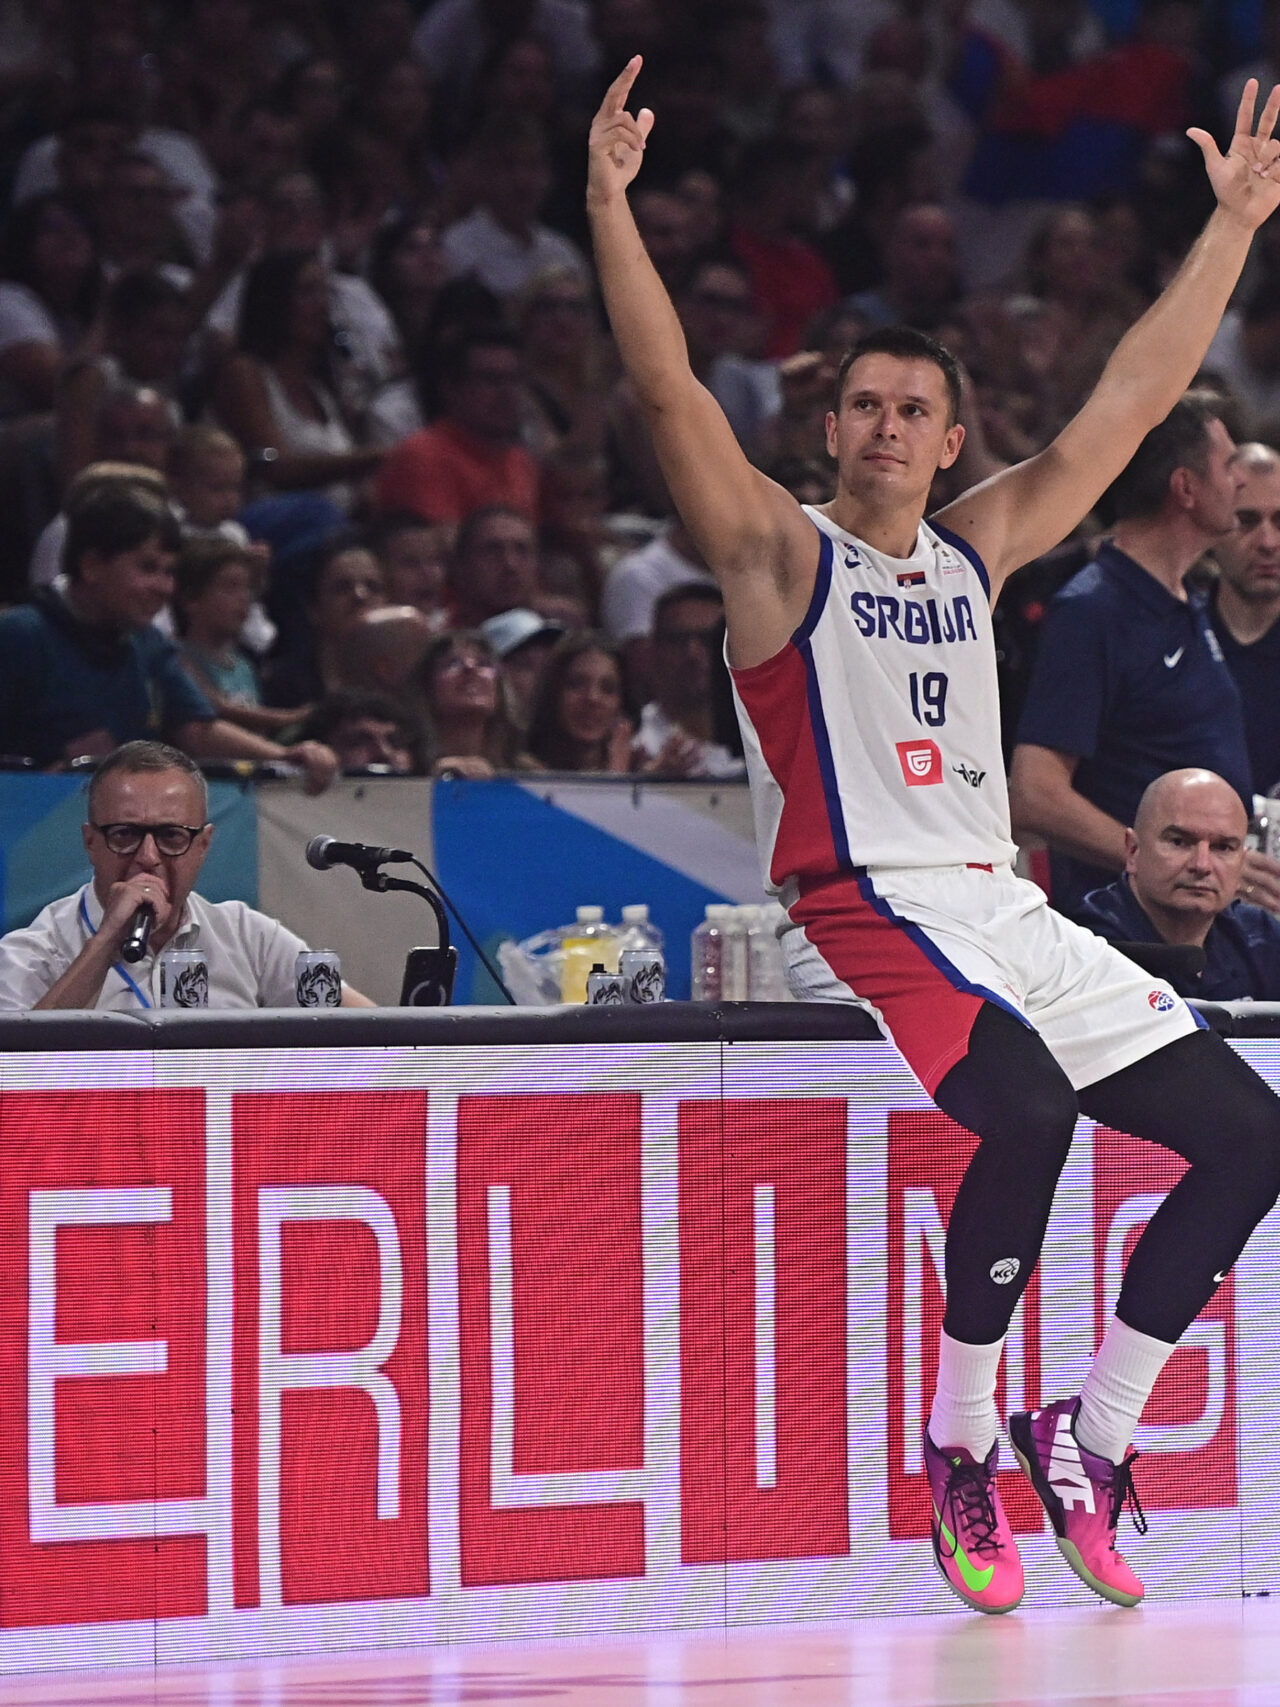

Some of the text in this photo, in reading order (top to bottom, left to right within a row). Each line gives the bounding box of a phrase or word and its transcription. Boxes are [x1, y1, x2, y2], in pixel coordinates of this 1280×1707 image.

[850, 591, 978, 645] SRBIJA
[908, 671, 949, 728] 19
[1046, 1411, 1097, 1514] NIKE
